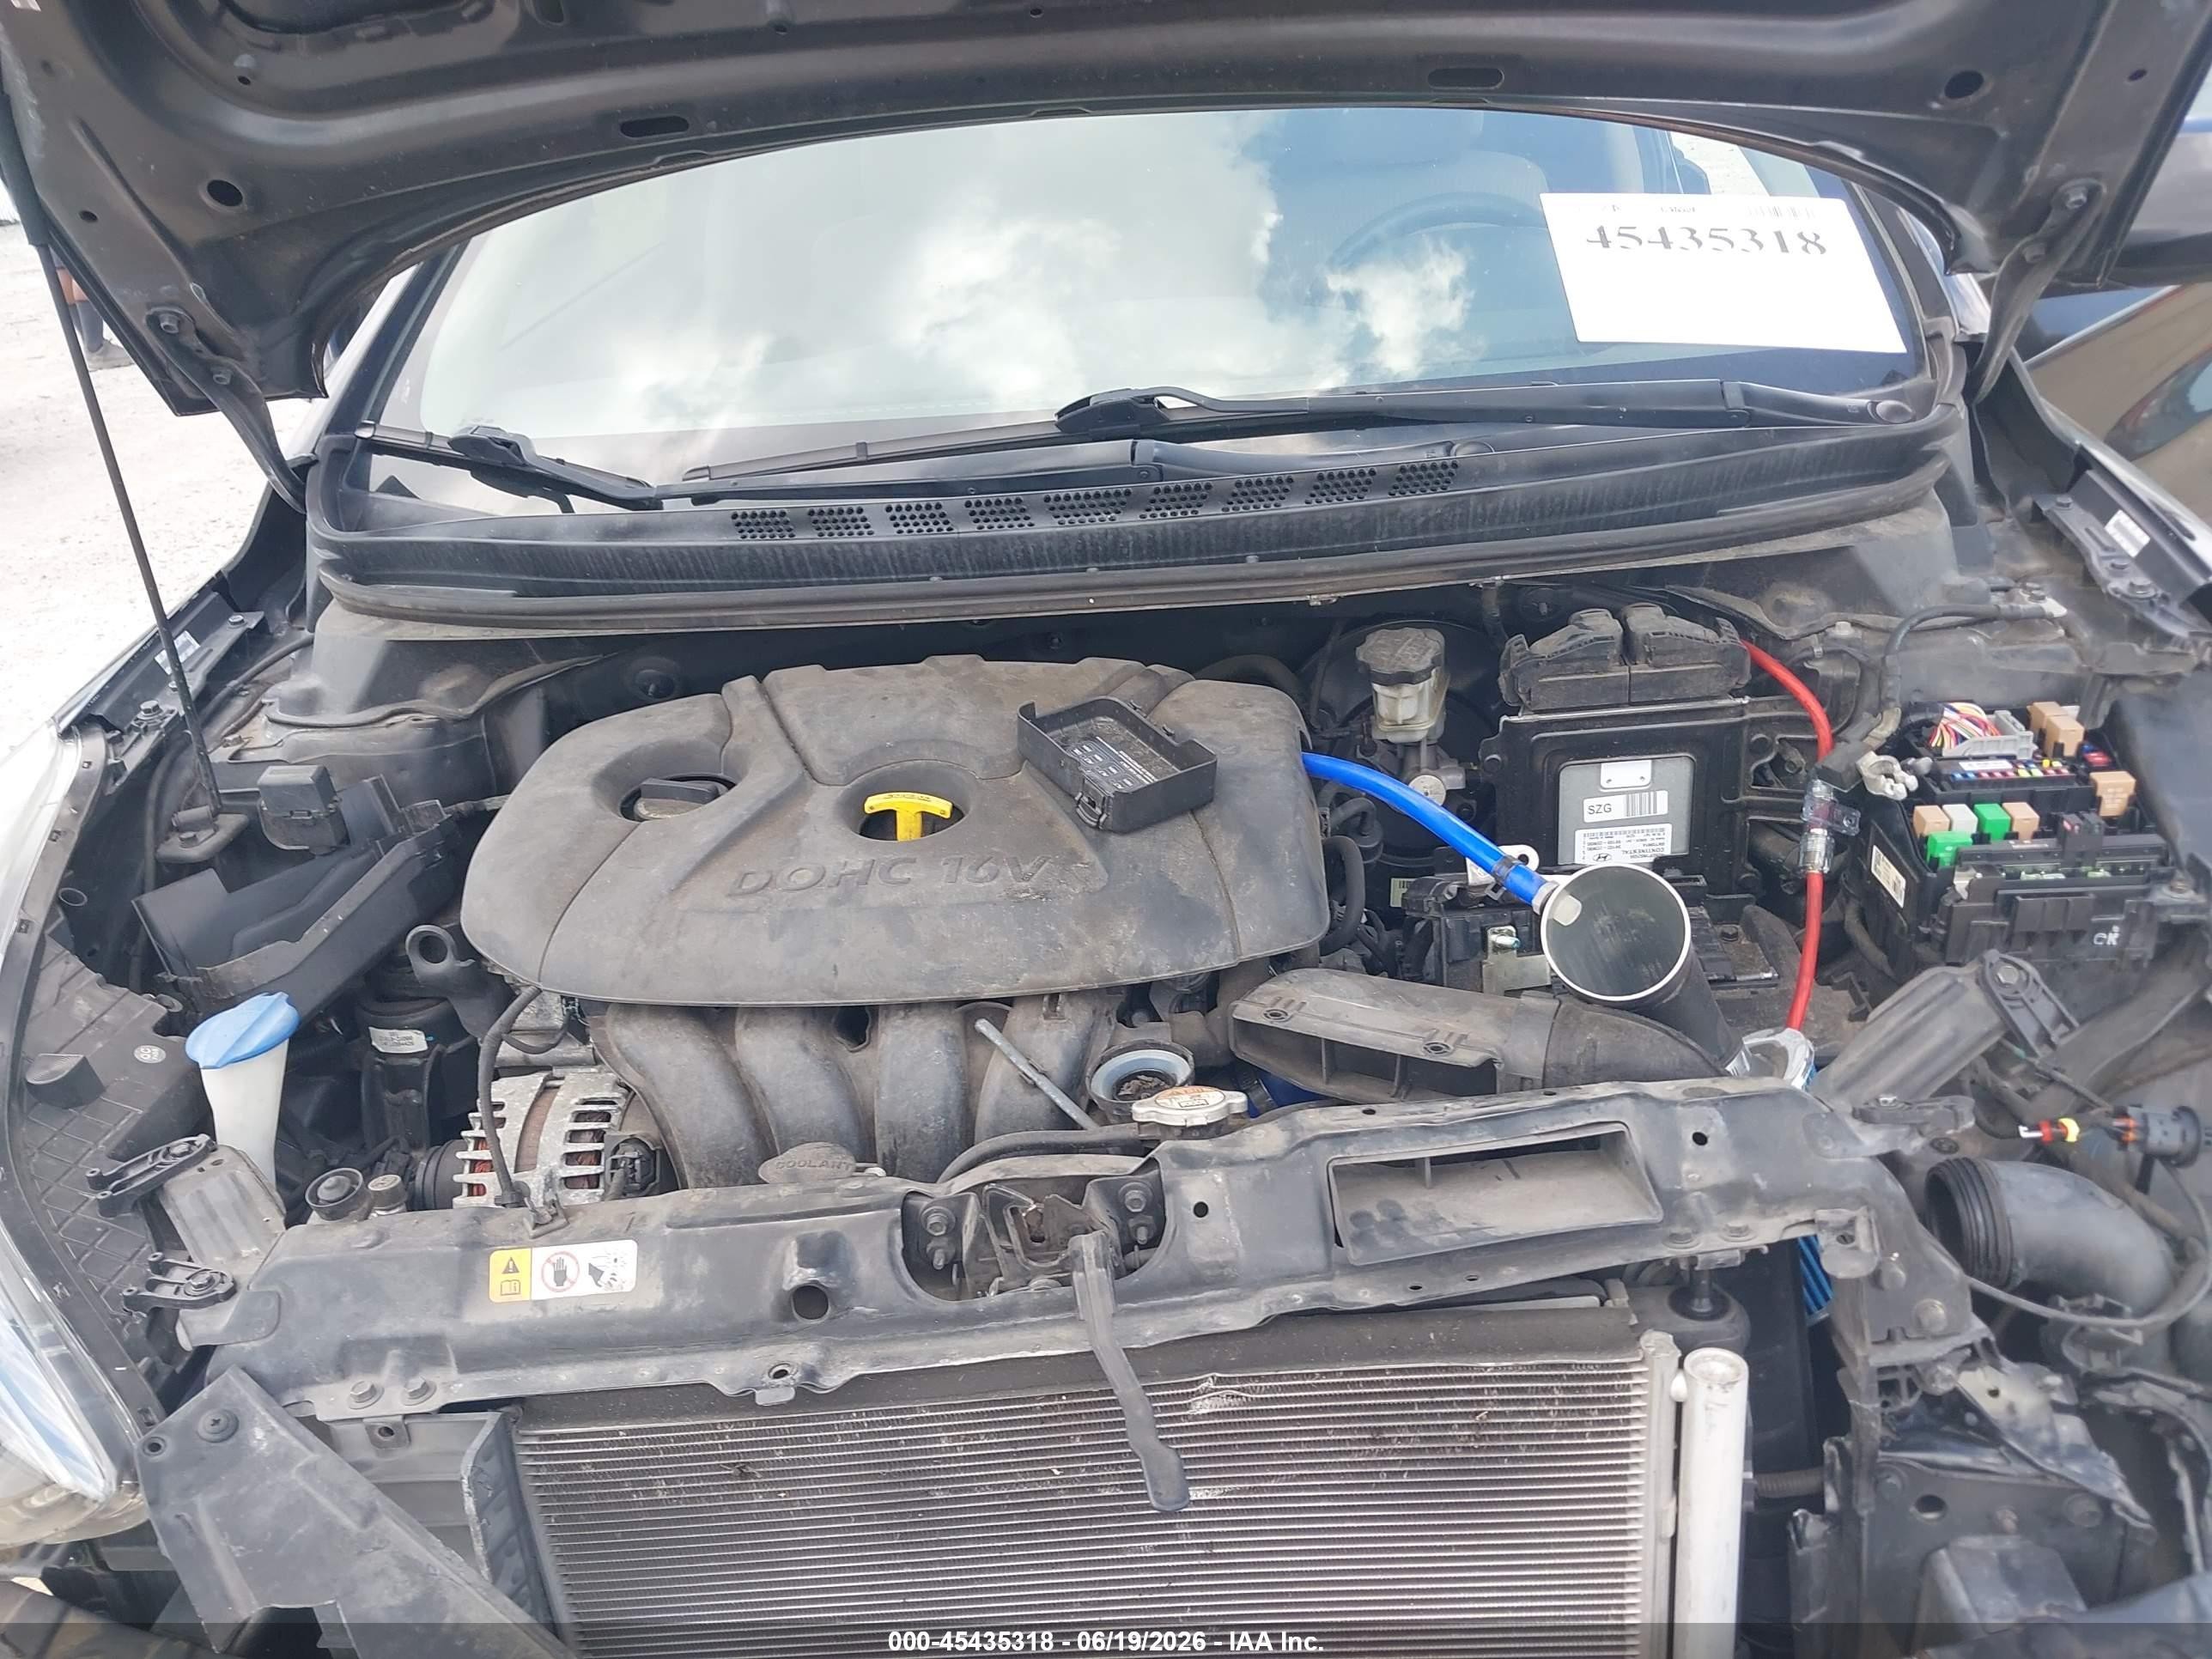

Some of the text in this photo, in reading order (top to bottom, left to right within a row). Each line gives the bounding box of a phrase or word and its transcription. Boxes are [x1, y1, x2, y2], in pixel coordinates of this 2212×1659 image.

[1587, 225, 1826, 255] 45435318
[1588, 804, 1612, 815] SZG
[727, 854, 1048, 896] DOHC 16V
[775, 1159, 852, 1171] COOLANT
